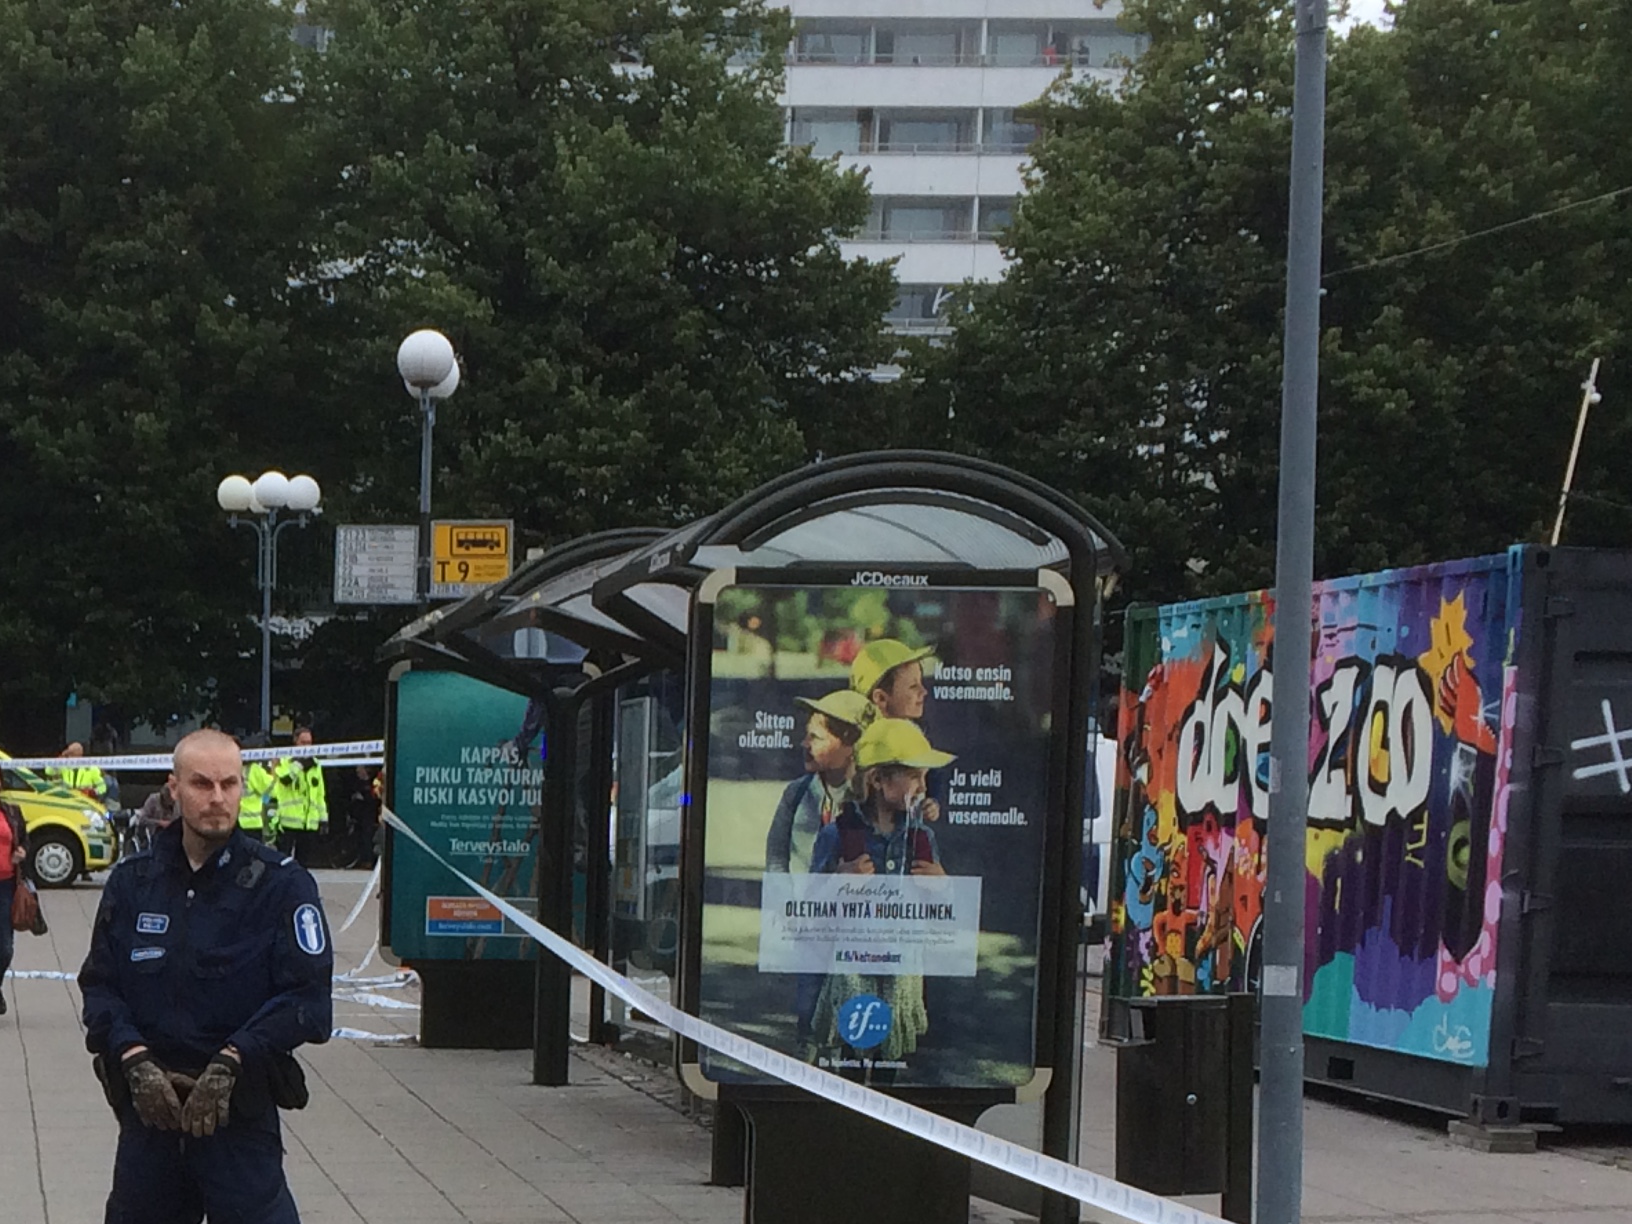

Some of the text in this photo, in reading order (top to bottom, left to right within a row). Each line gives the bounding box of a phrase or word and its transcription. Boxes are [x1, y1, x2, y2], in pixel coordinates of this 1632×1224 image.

[437, 561, 450, 582] T
[458, 561, 469, 582] 9
[851, 571, 929, 586] JCDecaux
[934, 662, 1012, 682] Katso ensin
[933, 682, 1015, 701] vasemmalle.
[755, 711, 795, 730] Sitten
[738, 731, 794, 749] oikealle.
[460, 746, 524, 767] KAPPAS,
[415, 766, 462, 784] PIKKU
[949, 769, 1002, 788] Ja vielä
[413, 787, 453, 805] RISKI
[457, 788, 514, 806] KASVOI
[948, 789, 991, 806] kerran
[948, 807, 1028, 826] vasemmalle.
[449, 838, 530, 855] Terveystalo
[786, 899, 956, 921] OLETHAN YHTÄ HUOLELLINEN.
